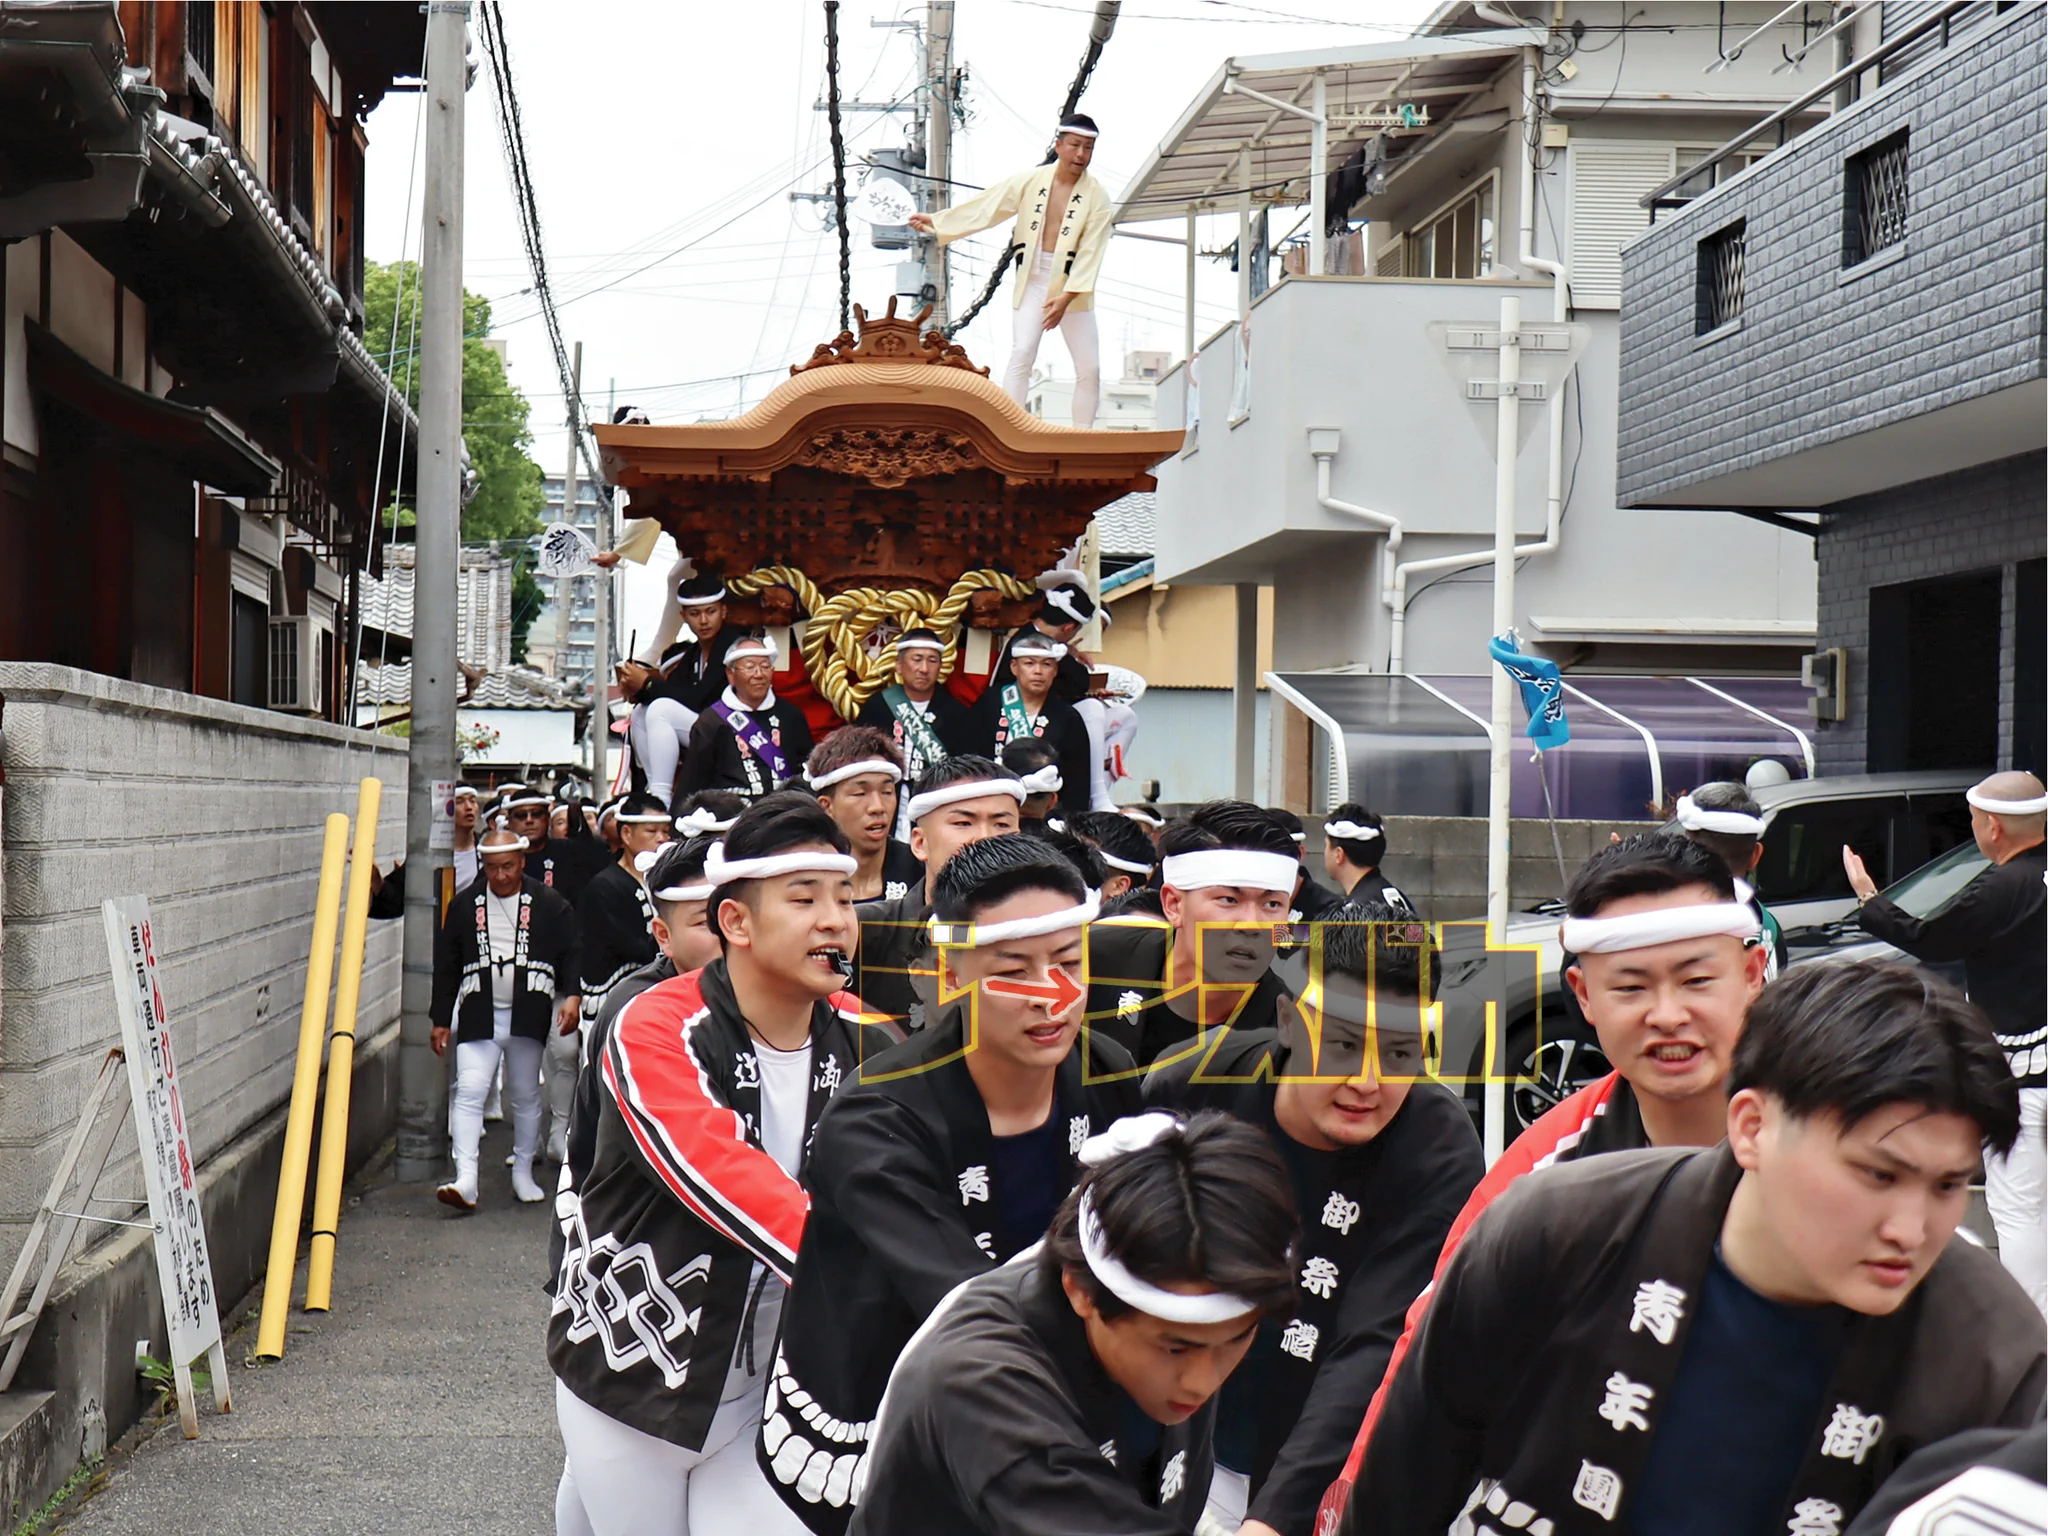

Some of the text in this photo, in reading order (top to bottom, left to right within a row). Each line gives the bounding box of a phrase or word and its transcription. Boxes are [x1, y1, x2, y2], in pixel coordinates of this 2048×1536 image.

[1031, 187, 1048, 231] 大工方
[1061, 193, 1083, 237] 大工方
